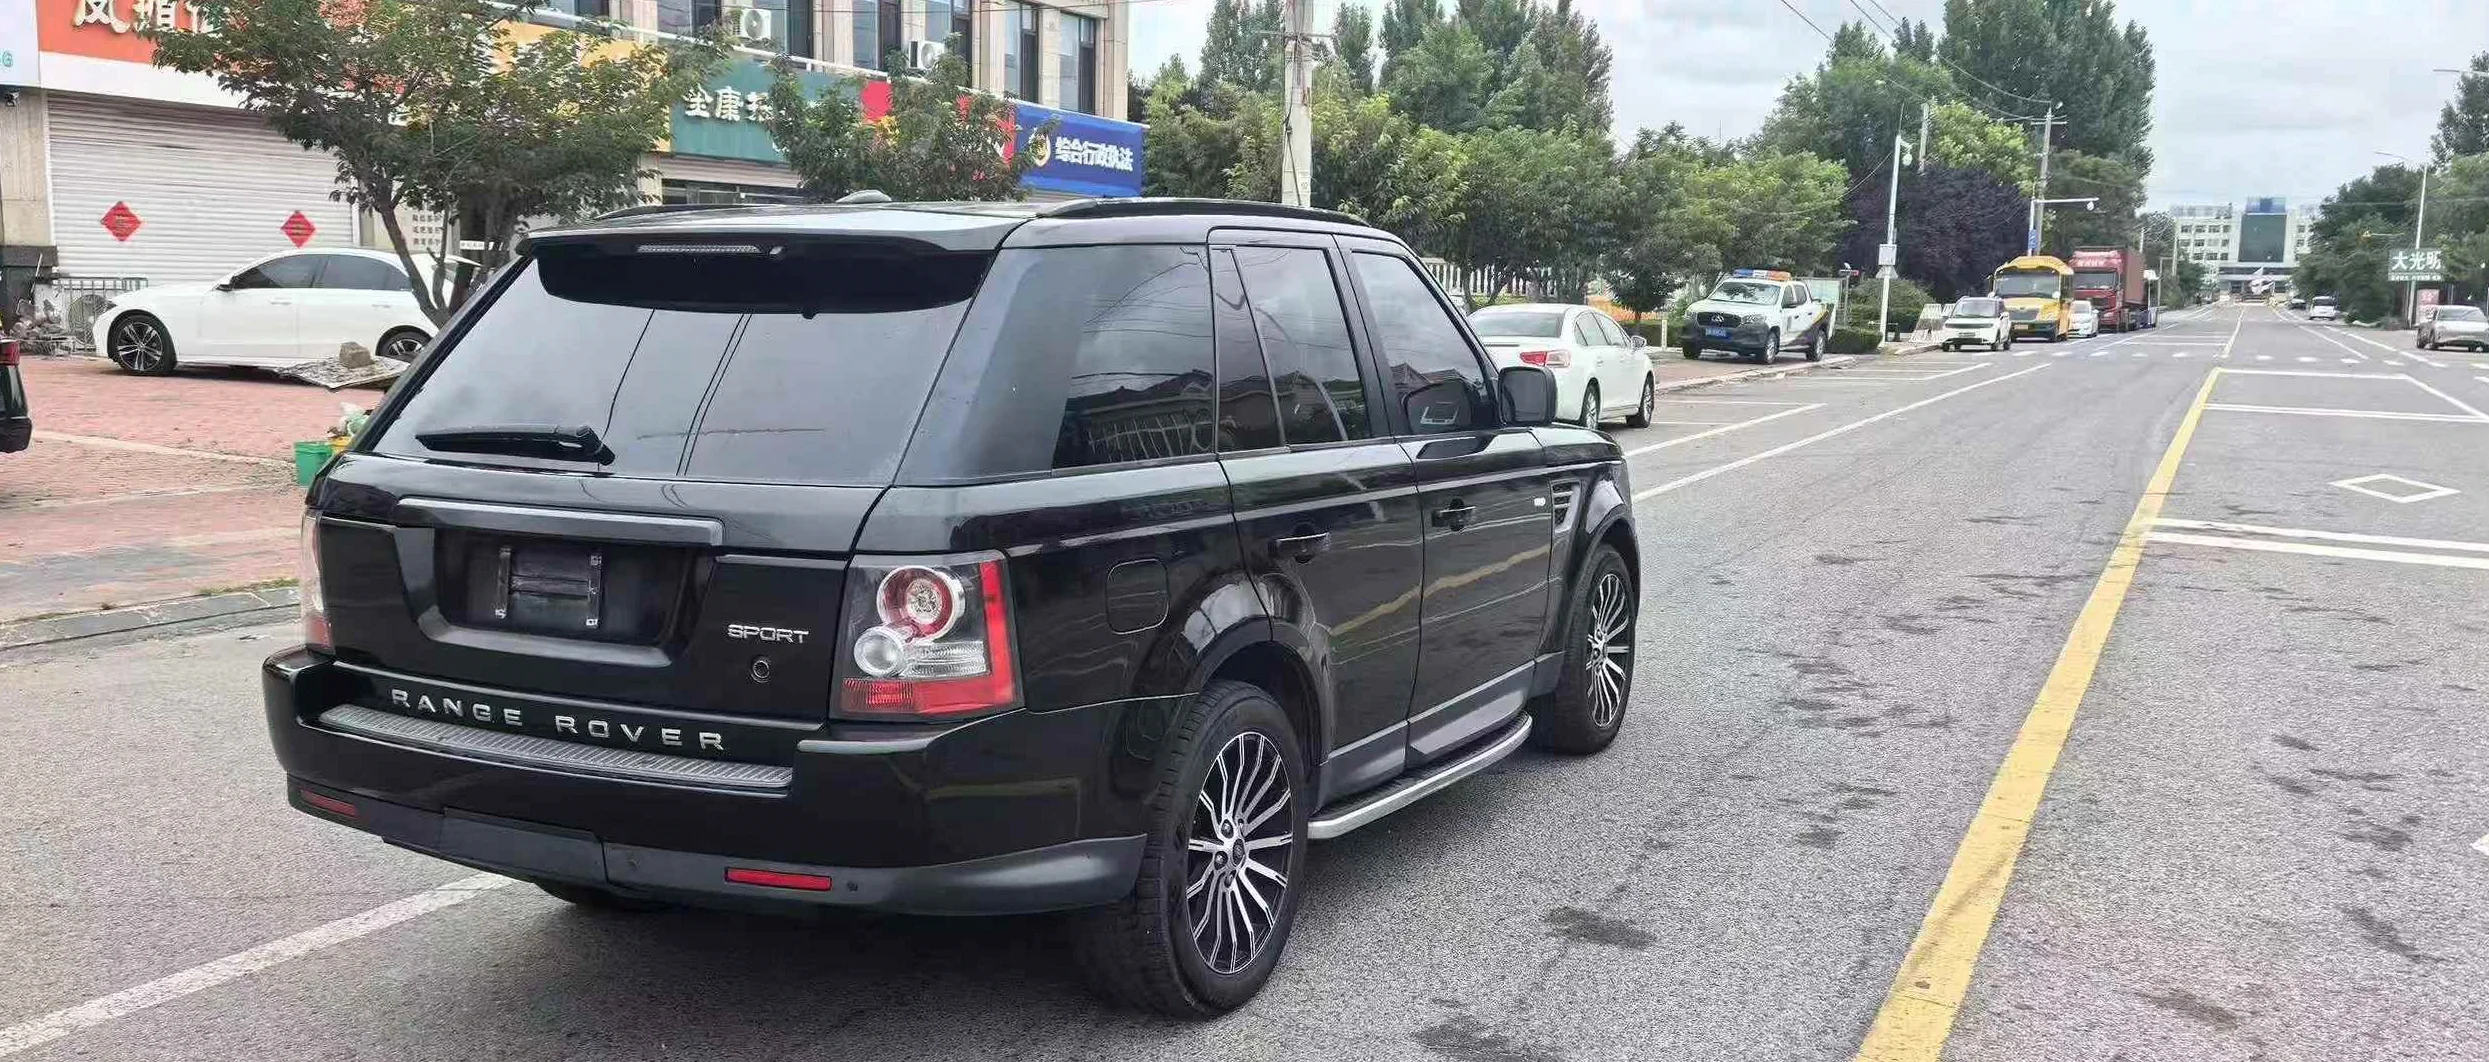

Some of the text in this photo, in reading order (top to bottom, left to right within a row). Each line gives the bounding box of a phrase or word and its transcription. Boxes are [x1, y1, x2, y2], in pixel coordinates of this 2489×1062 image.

[1055, 136, 1133, 172] 综合行政执法
[2391, 250, 2443, 271] 大光明
[727, 623, 810, 644] SPORT
[391, 688, 725, 751] RANGE ROVER
